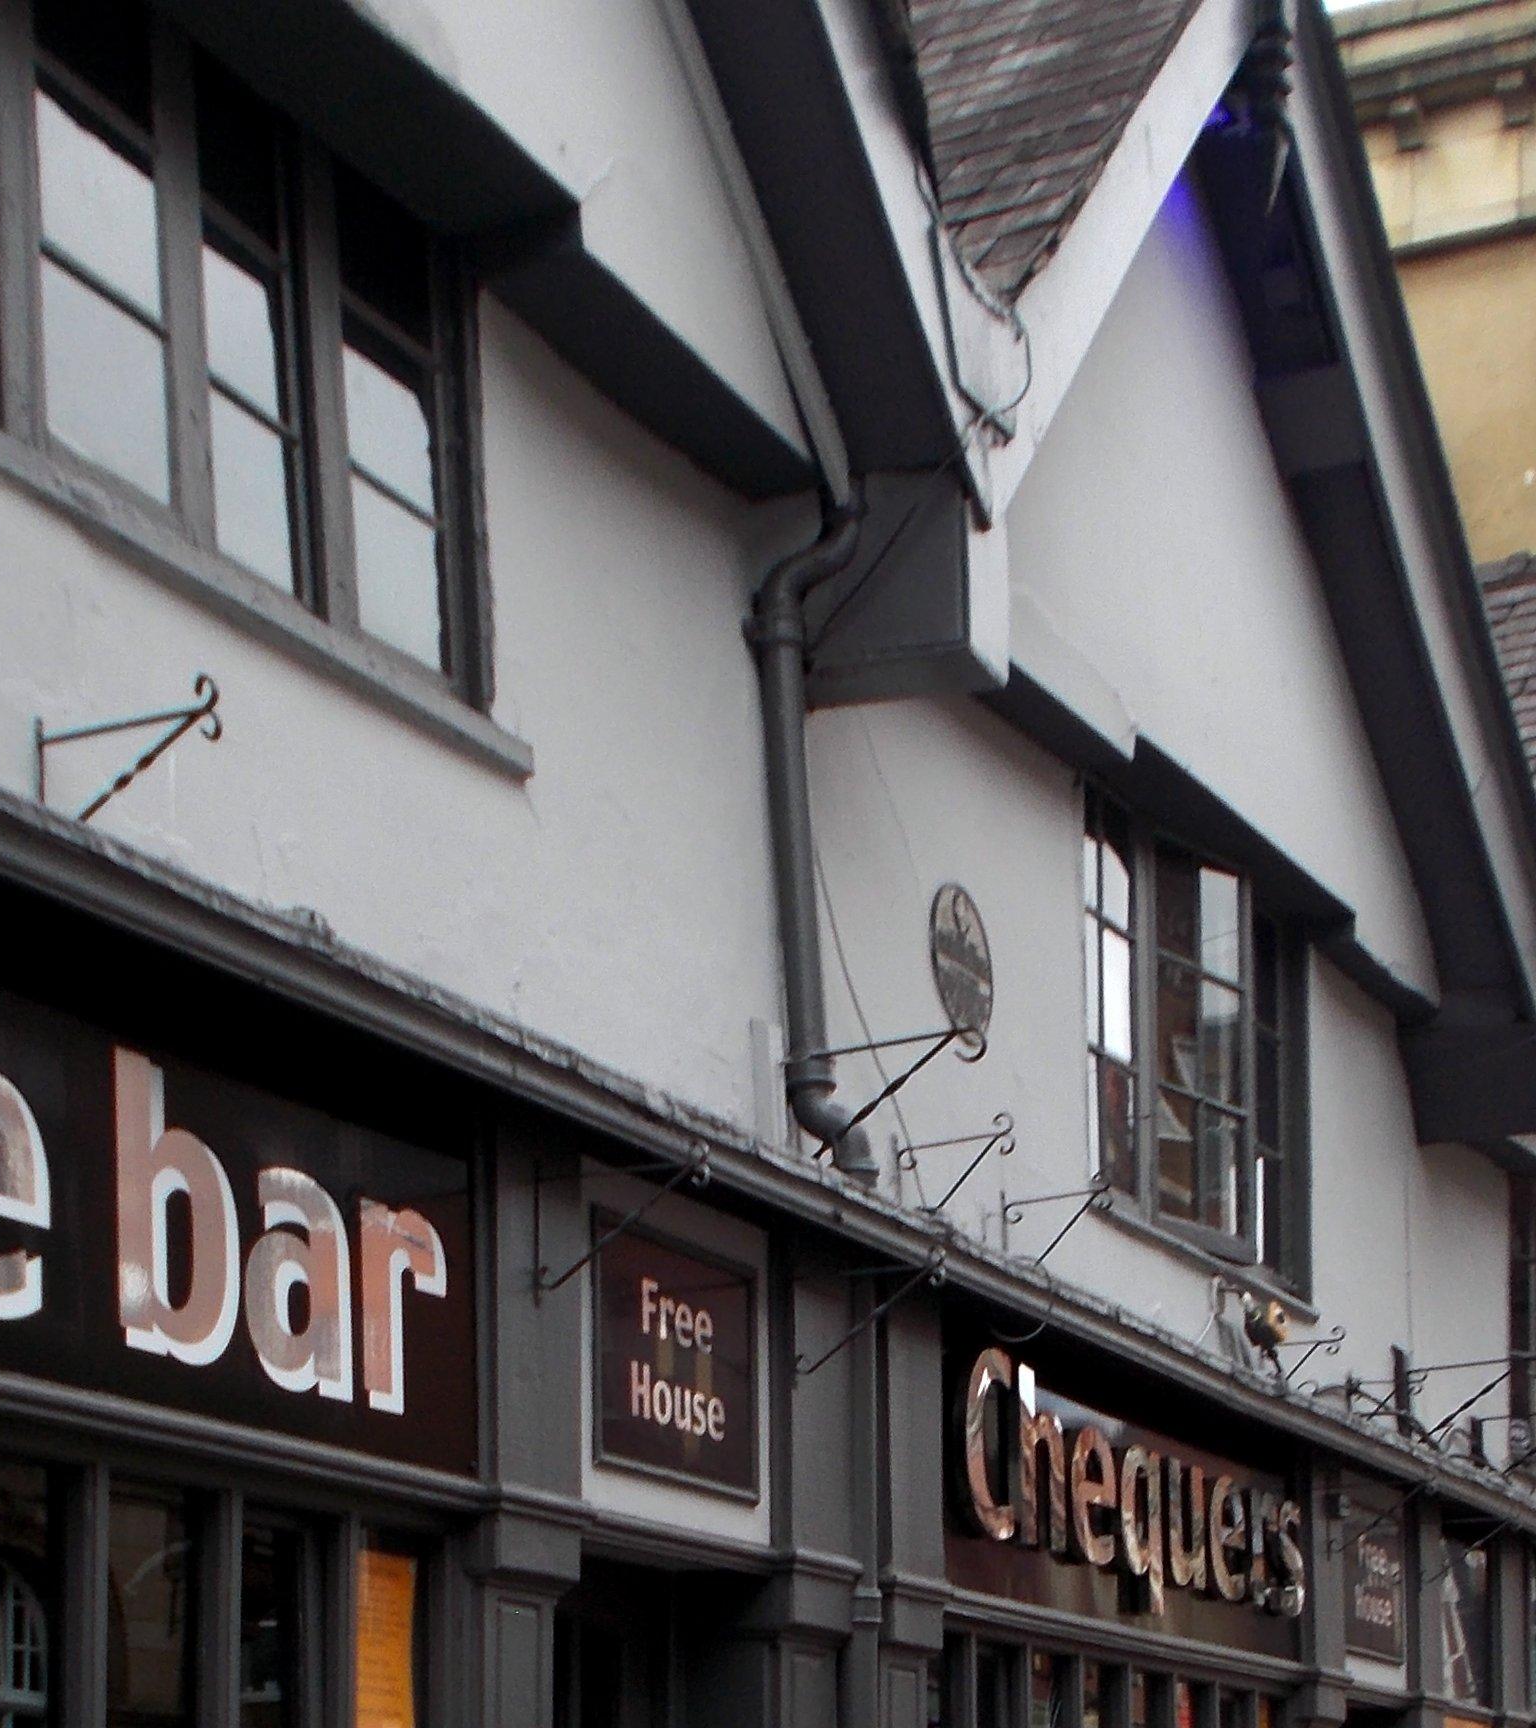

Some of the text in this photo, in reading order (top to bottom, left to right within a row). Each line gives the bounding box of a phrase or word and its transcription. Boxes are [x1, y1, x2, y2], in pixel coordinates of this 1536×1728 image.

[113, 1046, 448, 1415] bar
[640, 1276, 714, 1354] Free
[629, 1360, 726, 1442] House
[965, 1346, 1306, 1618] Chequers
